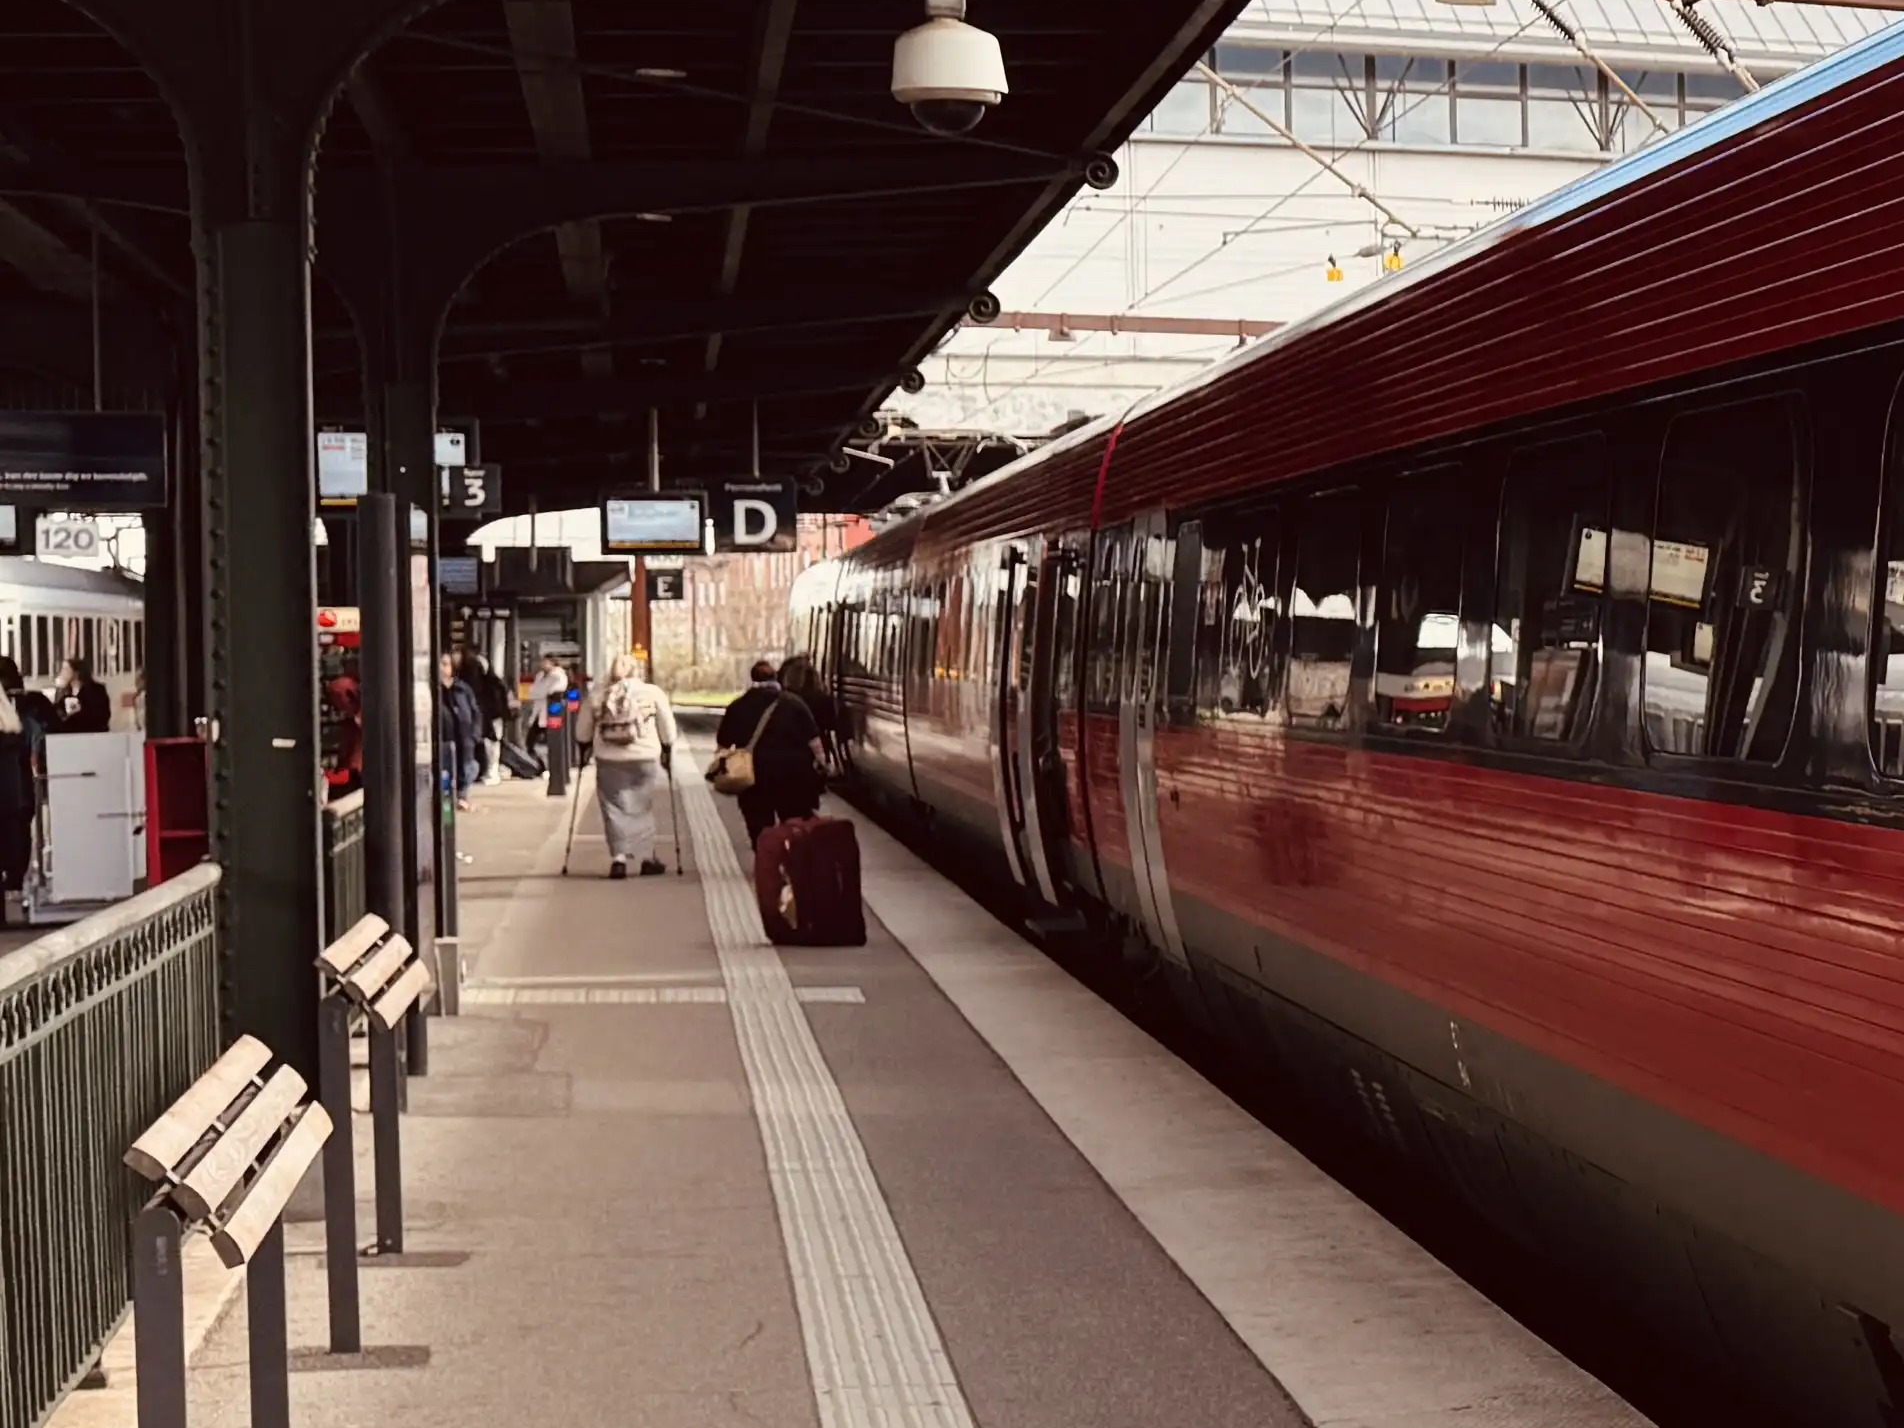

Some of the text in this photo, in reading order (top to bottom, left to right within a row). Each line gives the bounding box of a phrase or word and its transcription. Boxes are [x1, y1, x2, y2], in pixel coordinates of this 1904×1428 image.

[464, 478, 485, 507] 3
[733, 498, 778, 546] D
[41, 528, 94, 550] 120
[657, 576, 674, 598] E
